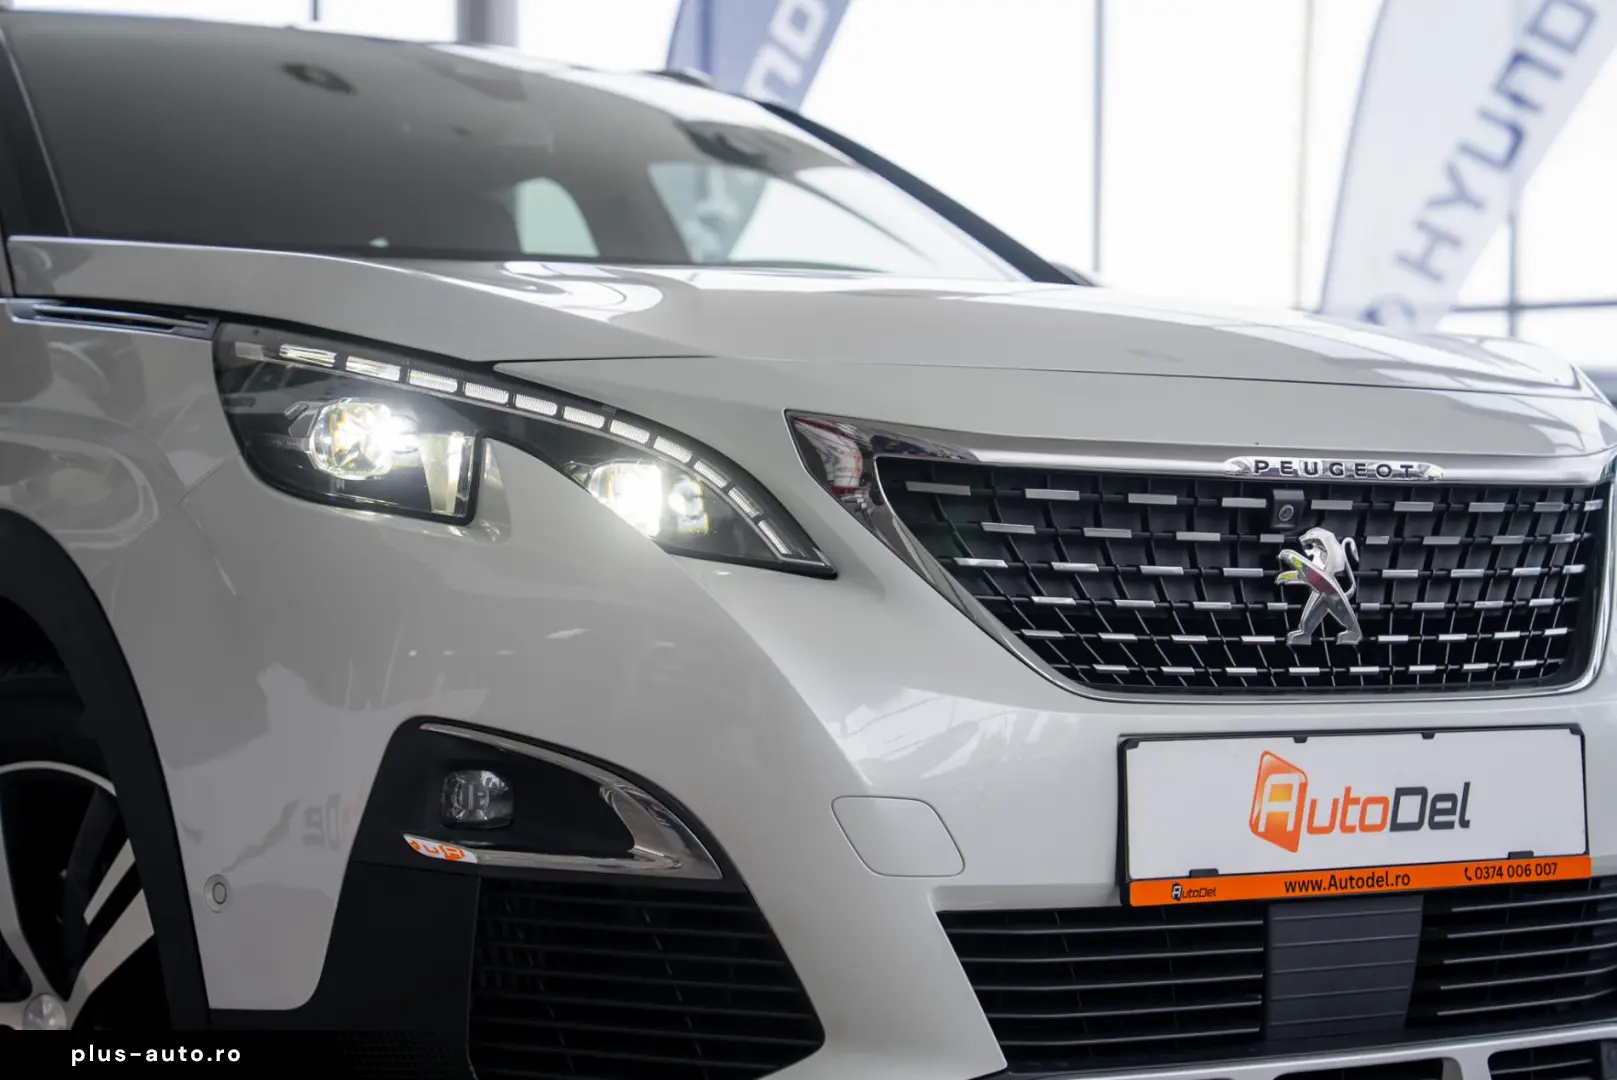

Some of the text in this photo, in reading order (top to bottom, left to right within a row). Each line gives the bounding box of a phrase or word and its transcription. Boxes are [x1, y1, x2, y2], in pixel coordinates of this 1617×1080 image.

[1254, 460, 1413, 478] PEUGEOT
[1250, 751, 1471, 852] AutoDel
[1475, 862, 1558, 880] 0374 006 007
[1172, 882, 1217, 901] AutoDel
[1284, 871, 1411, 893] www.Autodel.ro
